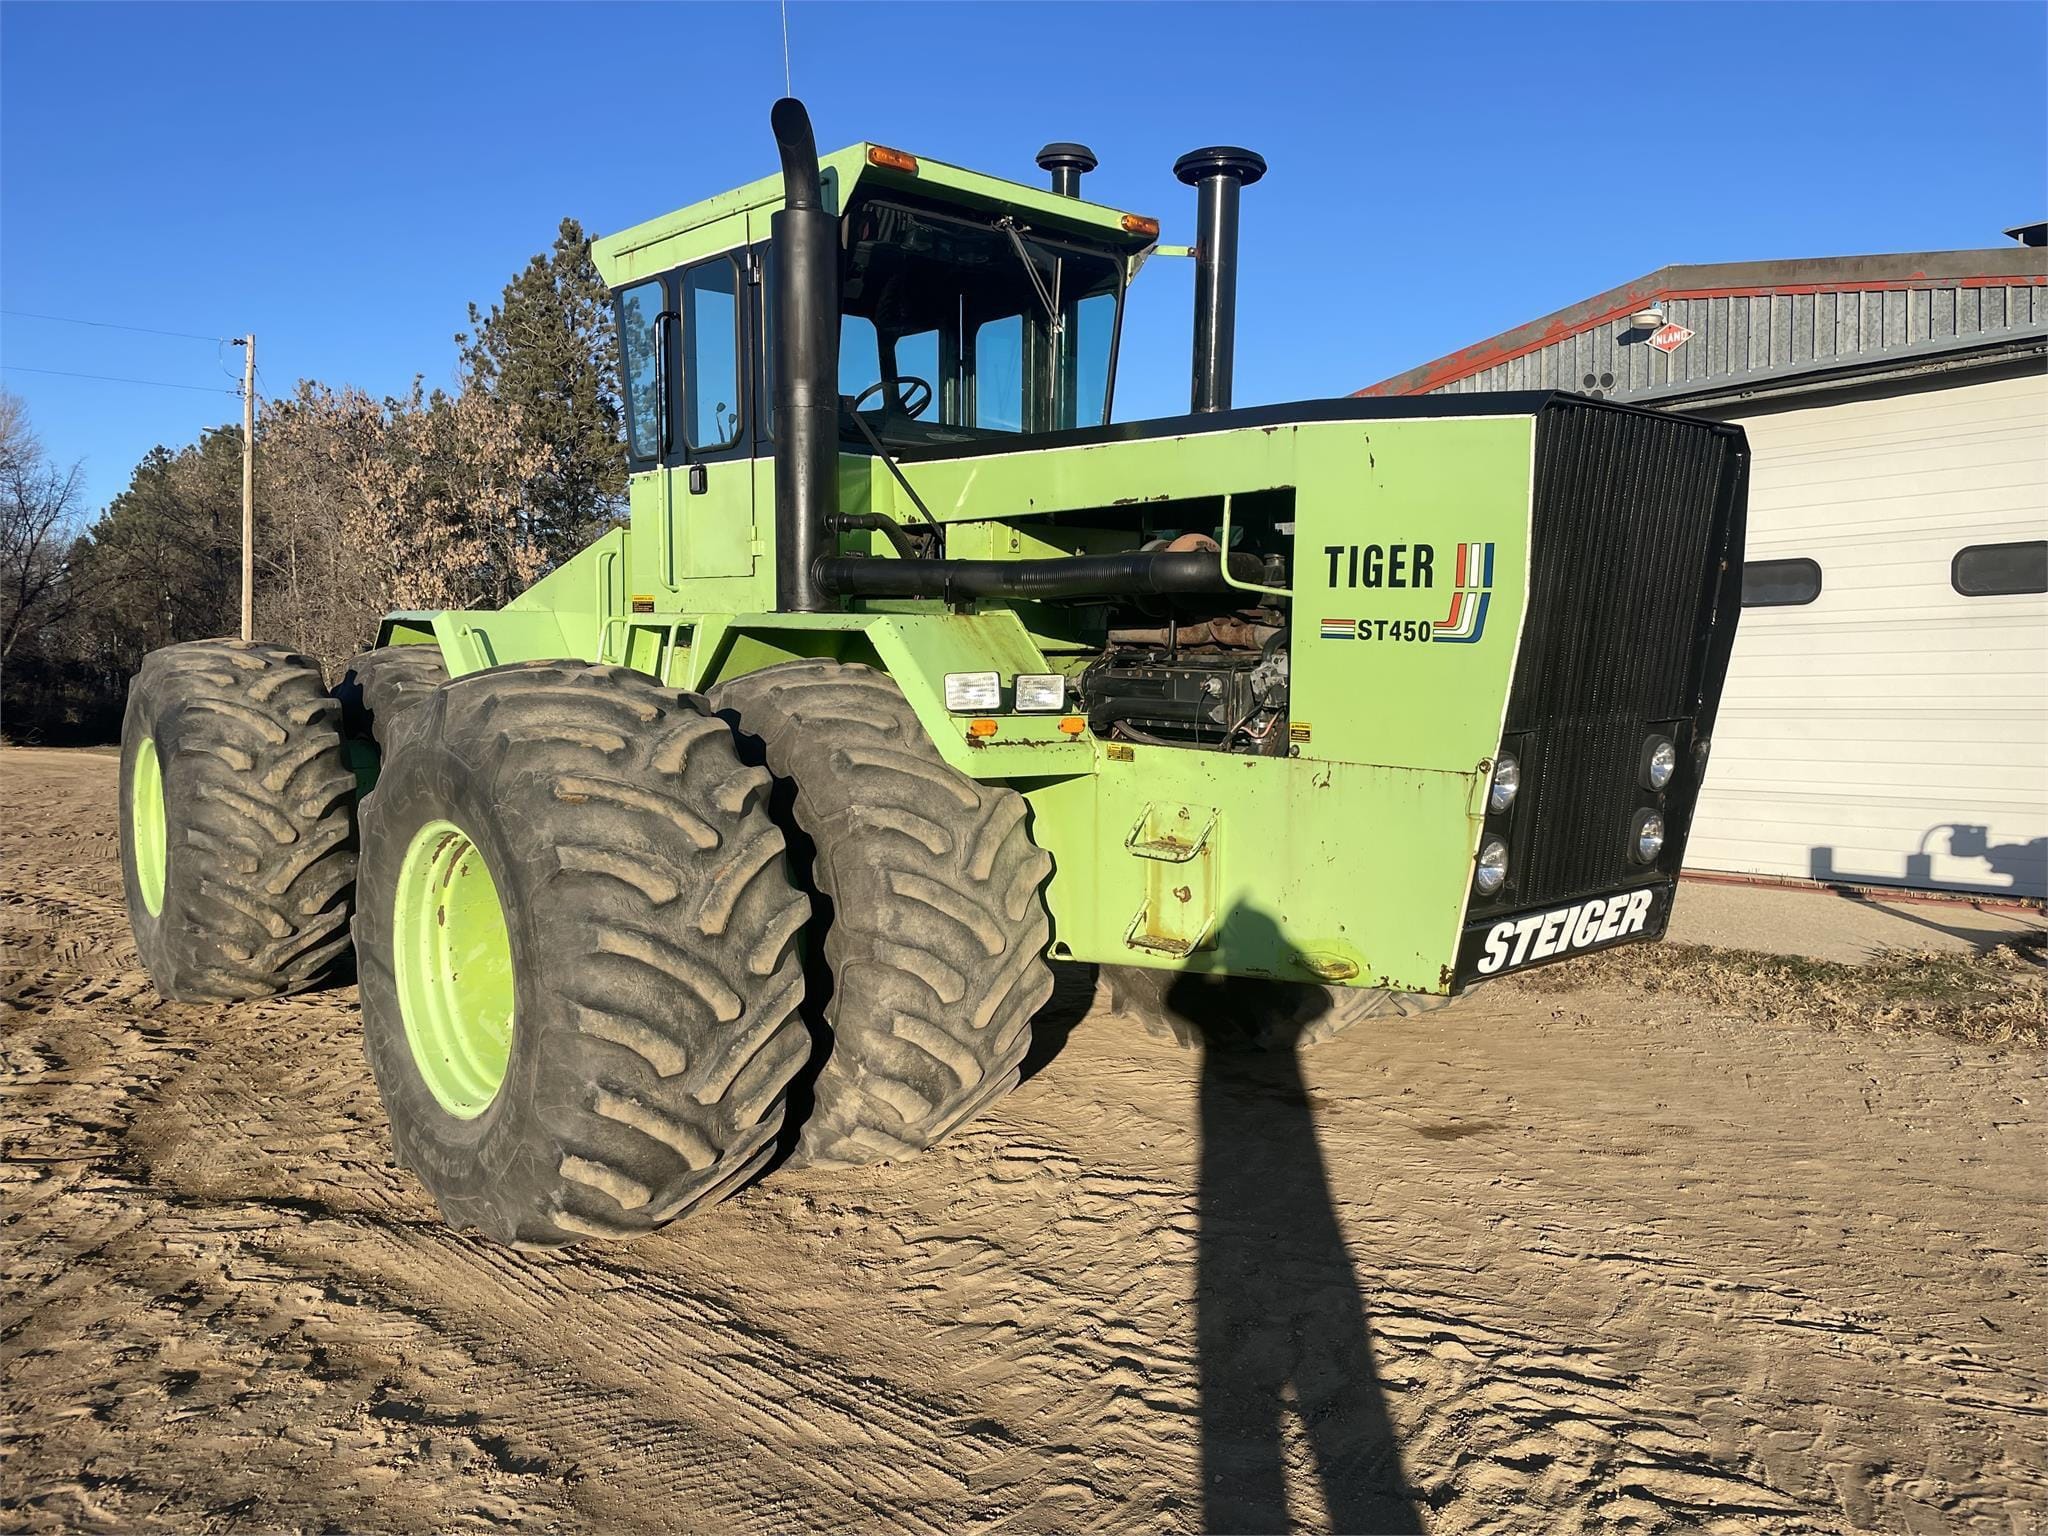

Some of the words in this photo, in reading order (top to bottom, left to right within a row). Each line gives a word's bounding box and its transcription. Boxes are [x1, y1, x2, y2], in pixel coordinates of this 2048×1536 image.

[1324, 544, 1434, 589] TIGER
[1357, 620, 1431, 643] ST450
[1477, 889, 1653, 974] STEIGER
